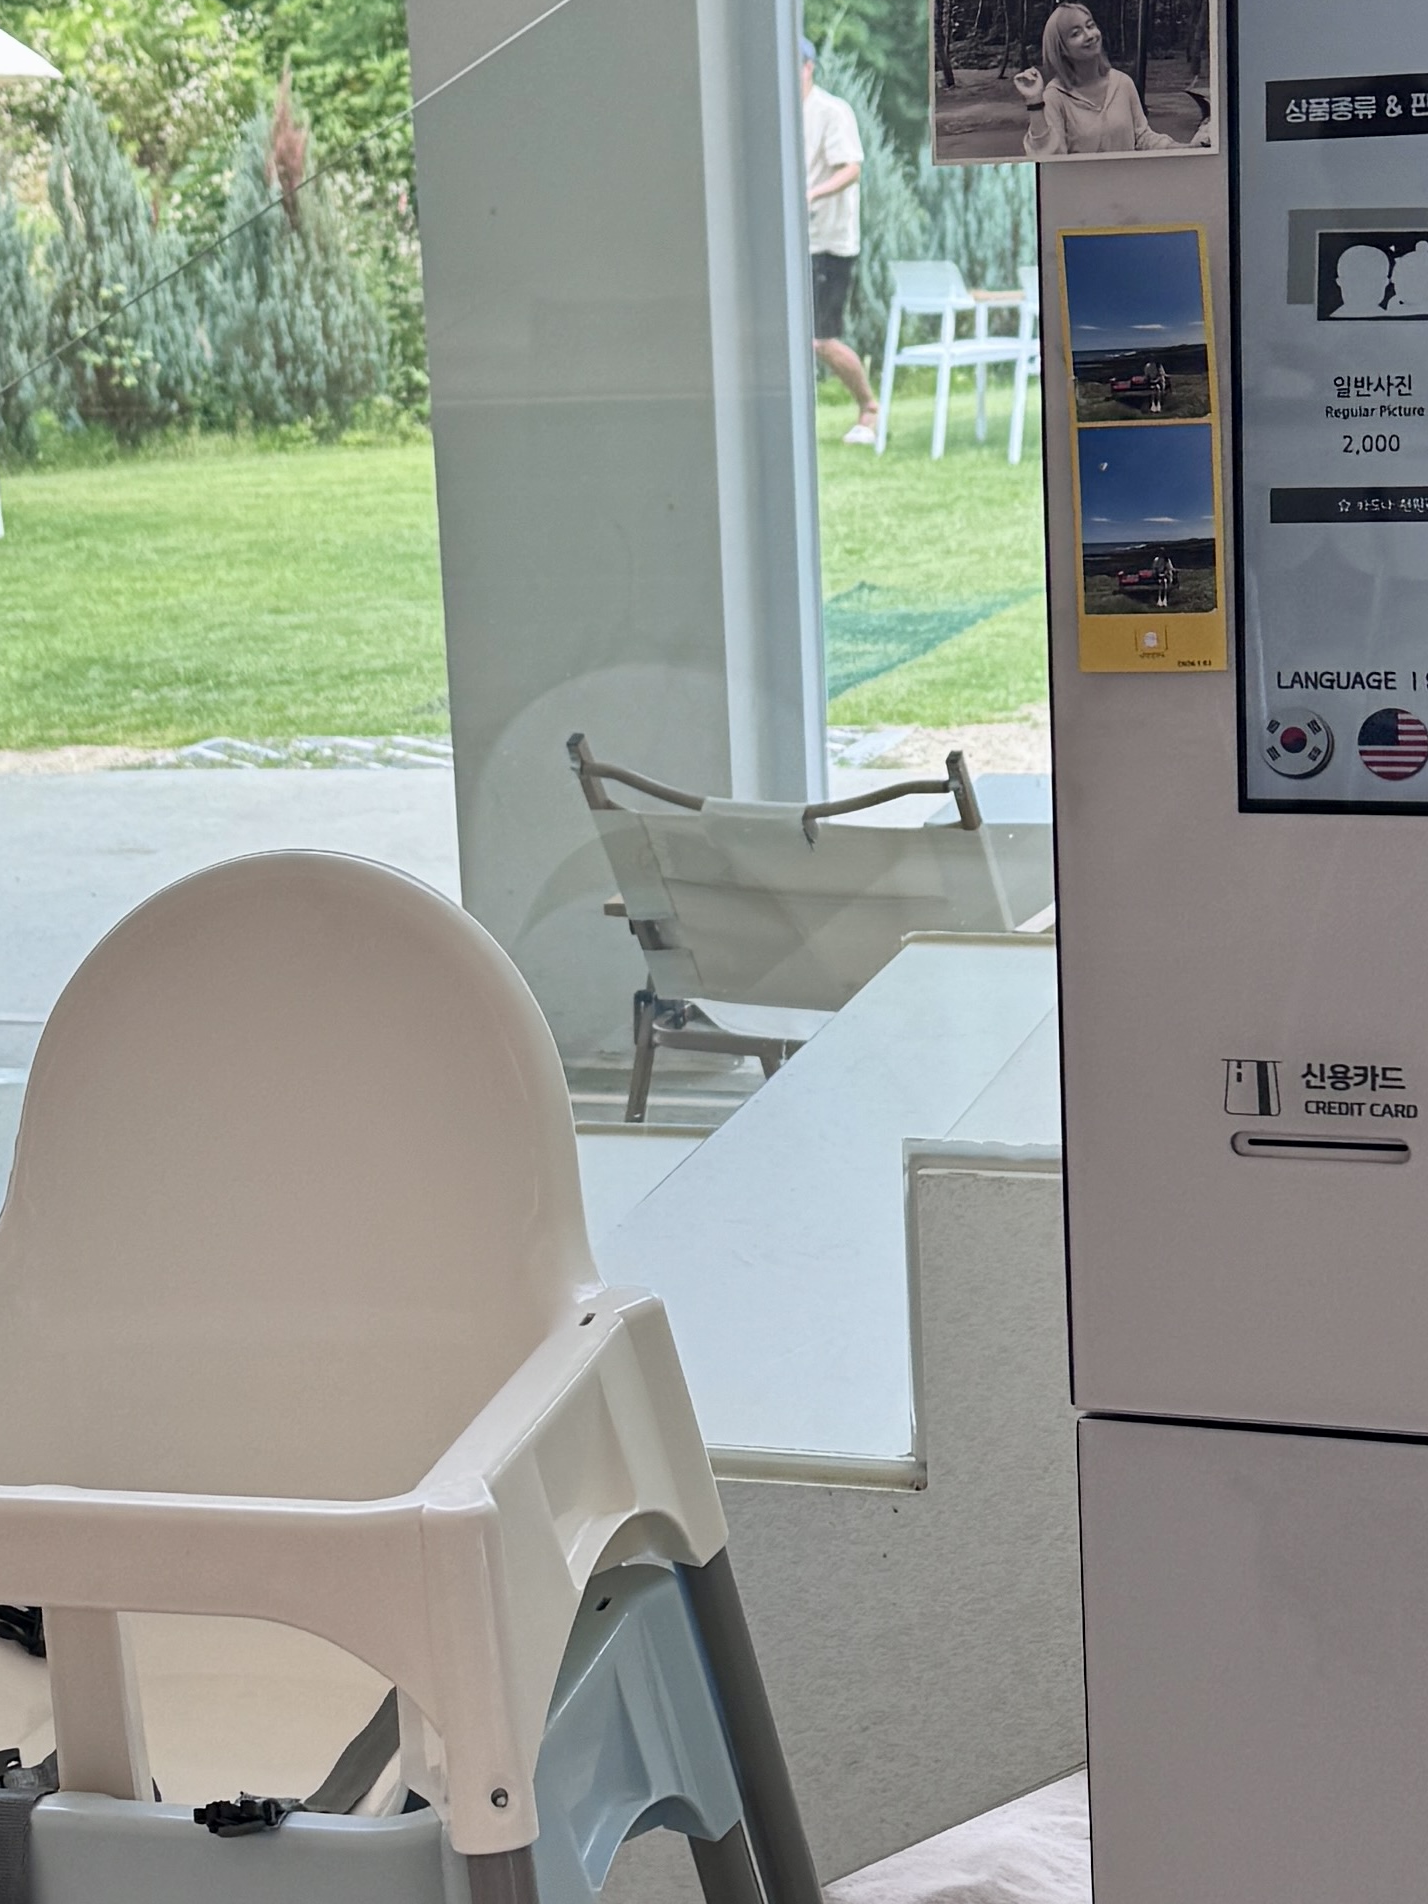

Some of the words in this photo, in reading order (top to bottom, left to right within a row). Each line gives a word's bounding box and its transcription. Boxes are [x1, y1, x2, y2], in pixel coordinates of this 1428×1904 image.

[1285, 93, 1377, 123] 상품종류
[1385, 96, 1404, 118] &
[1333, 373, 1413, 398] 일반사진
[1325, 405, 1376, 420] Regular
[1379, 404, 1425, 418] Picture
[1342, 434, 1401, 456] 2,000
[1276, 670, 1398, 691] LANGUAGE
[1300, 1062, 1407, 1092] 신용카드
[1304, 1099, 1366, 1118] CREDIT
[1369, 1101, 1419, 1119] CARD
